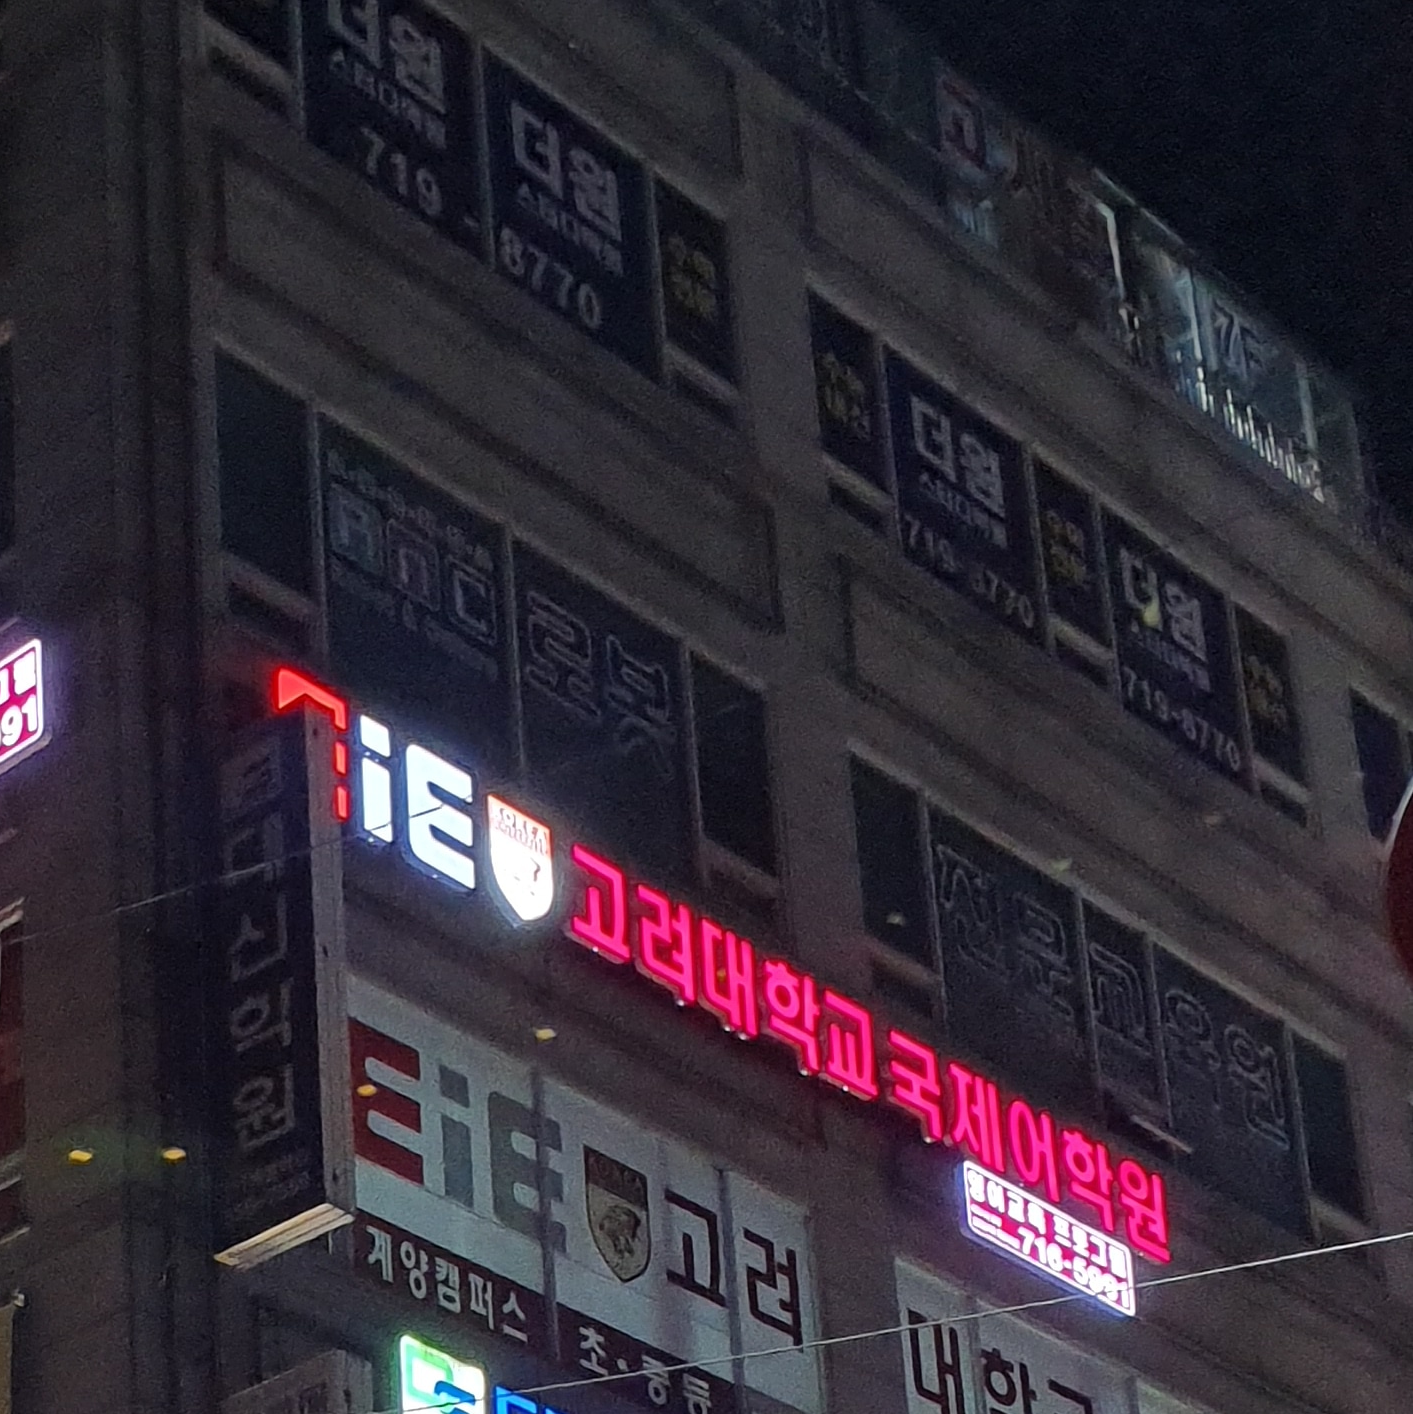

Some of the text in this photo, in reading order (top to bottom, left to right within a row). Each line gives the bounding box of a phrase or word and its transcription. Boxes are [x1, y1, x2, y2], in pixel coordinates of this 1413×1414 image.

[572, 843, 1171, 1263] 고려대학교 국제어학원
[366, 1225, 528, 1343] 계양캠퍼스
